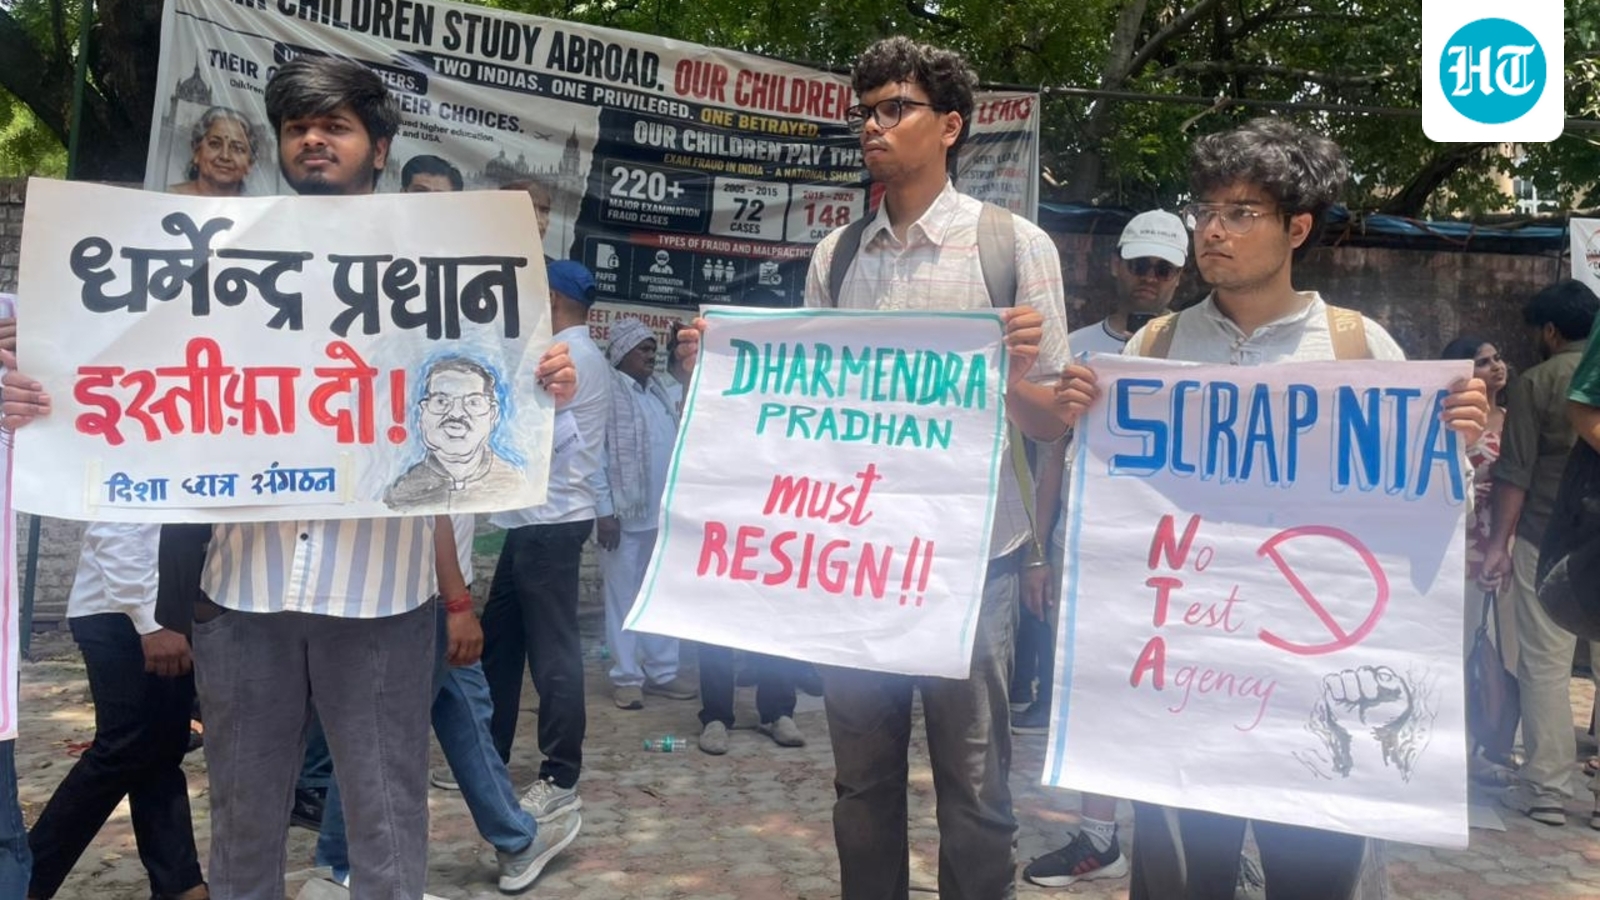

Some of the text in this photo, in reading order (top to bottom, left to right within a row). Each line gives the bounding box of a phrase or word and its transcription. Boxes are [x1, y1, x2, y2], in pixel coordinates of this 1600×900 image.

[209, 49, 259, 79] THEIR
[277, 0, 435, 46] CHILDREN
[443, 9, 542, 66] STUDY
[546, 31, 664, 93] ABROAD.
[673, 58, 728, 102] OUR
[735, 68, 852, 121] CHILDREN
[372, 67, 419, 91] TERS.
[434, 57, 820, 137] TWO INDIAS. ONE PRIVILEGED. ONE BETRAYED.
[420, 121, 448, 135] higher
[451, 127, 494, 142] education
[439, 102, 524, 134] CHOICES.
[633, 121, 865, 168] OUR CHILDREN PAY THE
[610, 166, 685, 202] 220+
[663, 153, 691, 168] EXAM
[693, 156, 723, 172] FRAUD
[725, 161, 737, 174] IN
[738, 162, 763, 176] INDIA
[775, 166, 782, 177] A
[784, 167, 829, 182] NATIONAL
[830, 170, 863, 183] SHAME
[609, 198, 701, 218] MAJOR EXAMINATION
[756, 187, 778, 197] 2015
[607, 209, 669, 226] FRAUD CASES
[733, 197, 765, 222] 72
[803, 202, 850, 228] 148
[658, 235, 686, 247] TYPES
[688, 237, 699, 250] OF
[701, 239, 730, 253] FRAUD
[732, 242, 751, 254] AND
[730, 222, 760, 234] CASES
[810, 229, 830, 240] CAS
[70, 211, 529, 341] धर्मेन्द्र प्रधान
[589, 308, 611, 323] EET
[721, 338, 987, 410] DHARMENDRA
[755, 402, 953, 450] PRADHAN
[1108, 378, 1466, 503] SCRAP NTA
[104, 472, 170, 502] दिशा
[252, 462, 336, 495] संगठन
[763, 463, 883, 527] must
[1147, 514, 1215, 572] No
[697, 521, 935, 607] RESIGN!!
[1145, 576, 1246, 634] Test
[1129, 636, 1278, 733] Agency
